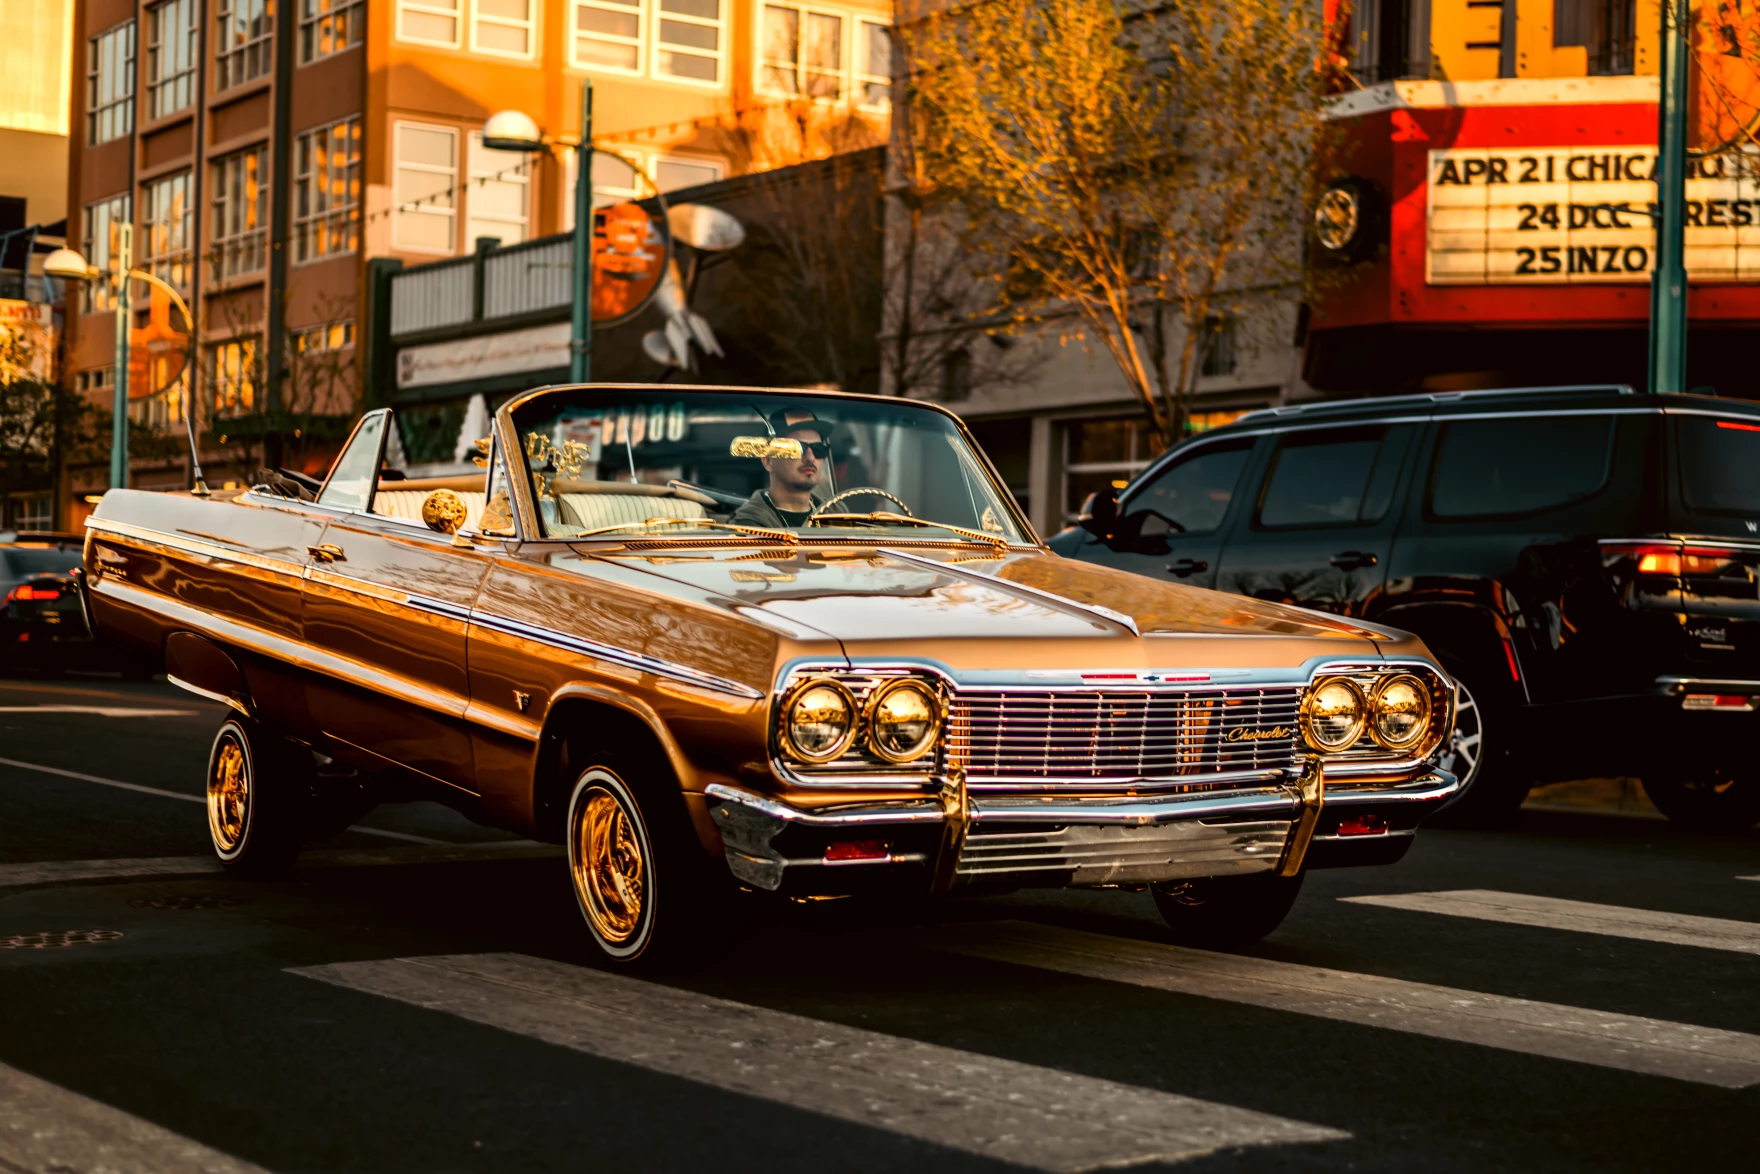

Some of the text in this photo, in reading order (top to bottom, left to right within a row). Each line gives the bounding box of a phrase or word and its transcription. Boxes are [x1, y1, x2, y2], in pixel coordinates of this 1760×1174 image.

[1437, 158, 1508, 185] APR
[1518, 156, 1555, 182] 21
[1517, 203, 1561, 231] 24
[1567, 203, 1632, 230] DCC
[1515, 246, 1648, 275] 25 INZO
[1228, 725, 1291, 742] Chevrolet
